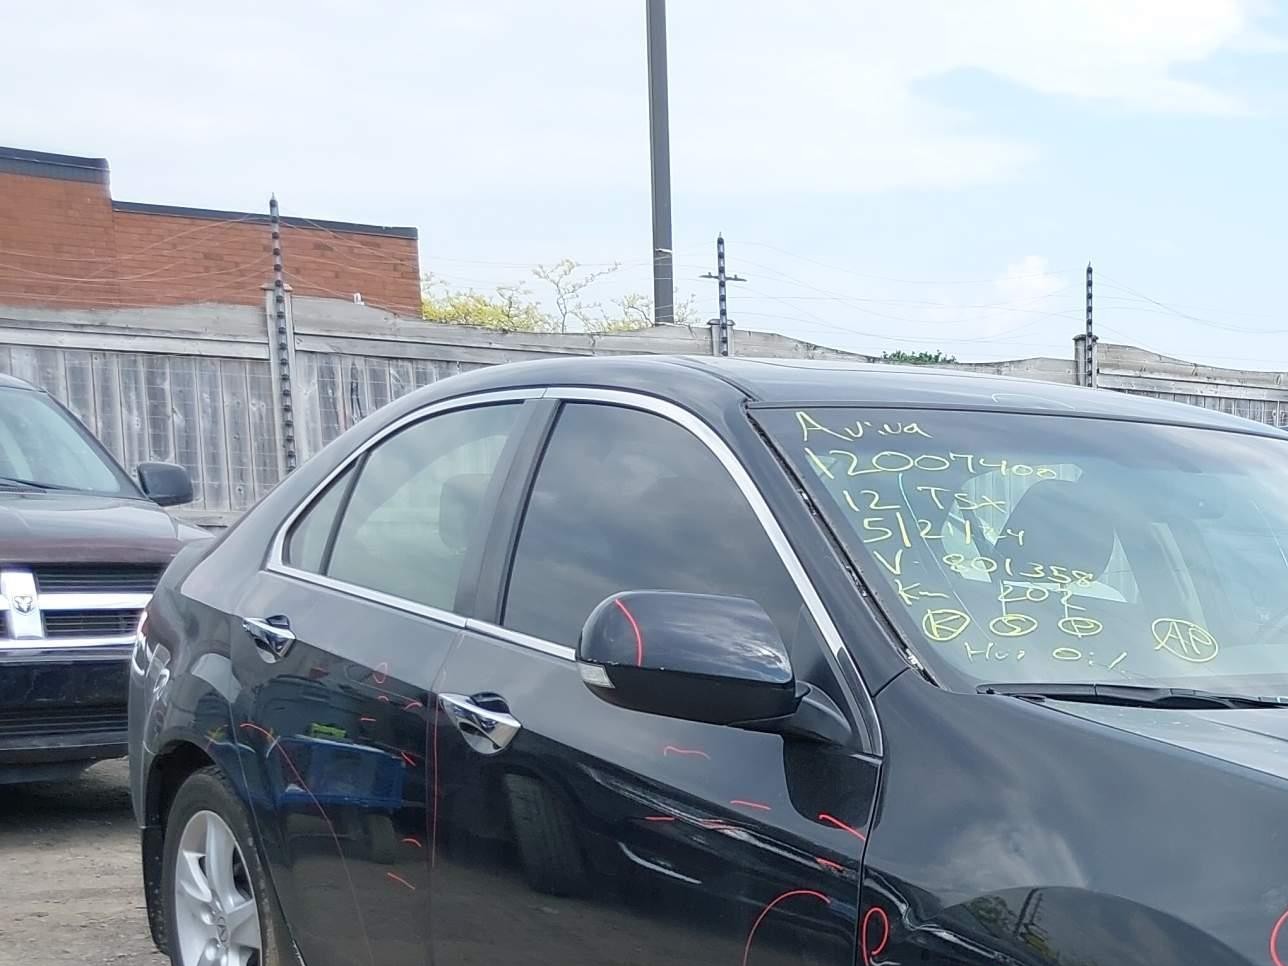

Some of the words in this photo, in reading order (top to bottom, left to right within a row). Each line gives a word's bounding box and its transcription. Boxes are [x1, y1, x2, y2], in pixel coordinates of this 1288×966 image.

[795, 410, 933, 442] Aviva
[803, 446, 1058, 481] 12007400
[842, 488, 901, 512] 12
[916, 485, 1007, 514] TSX
